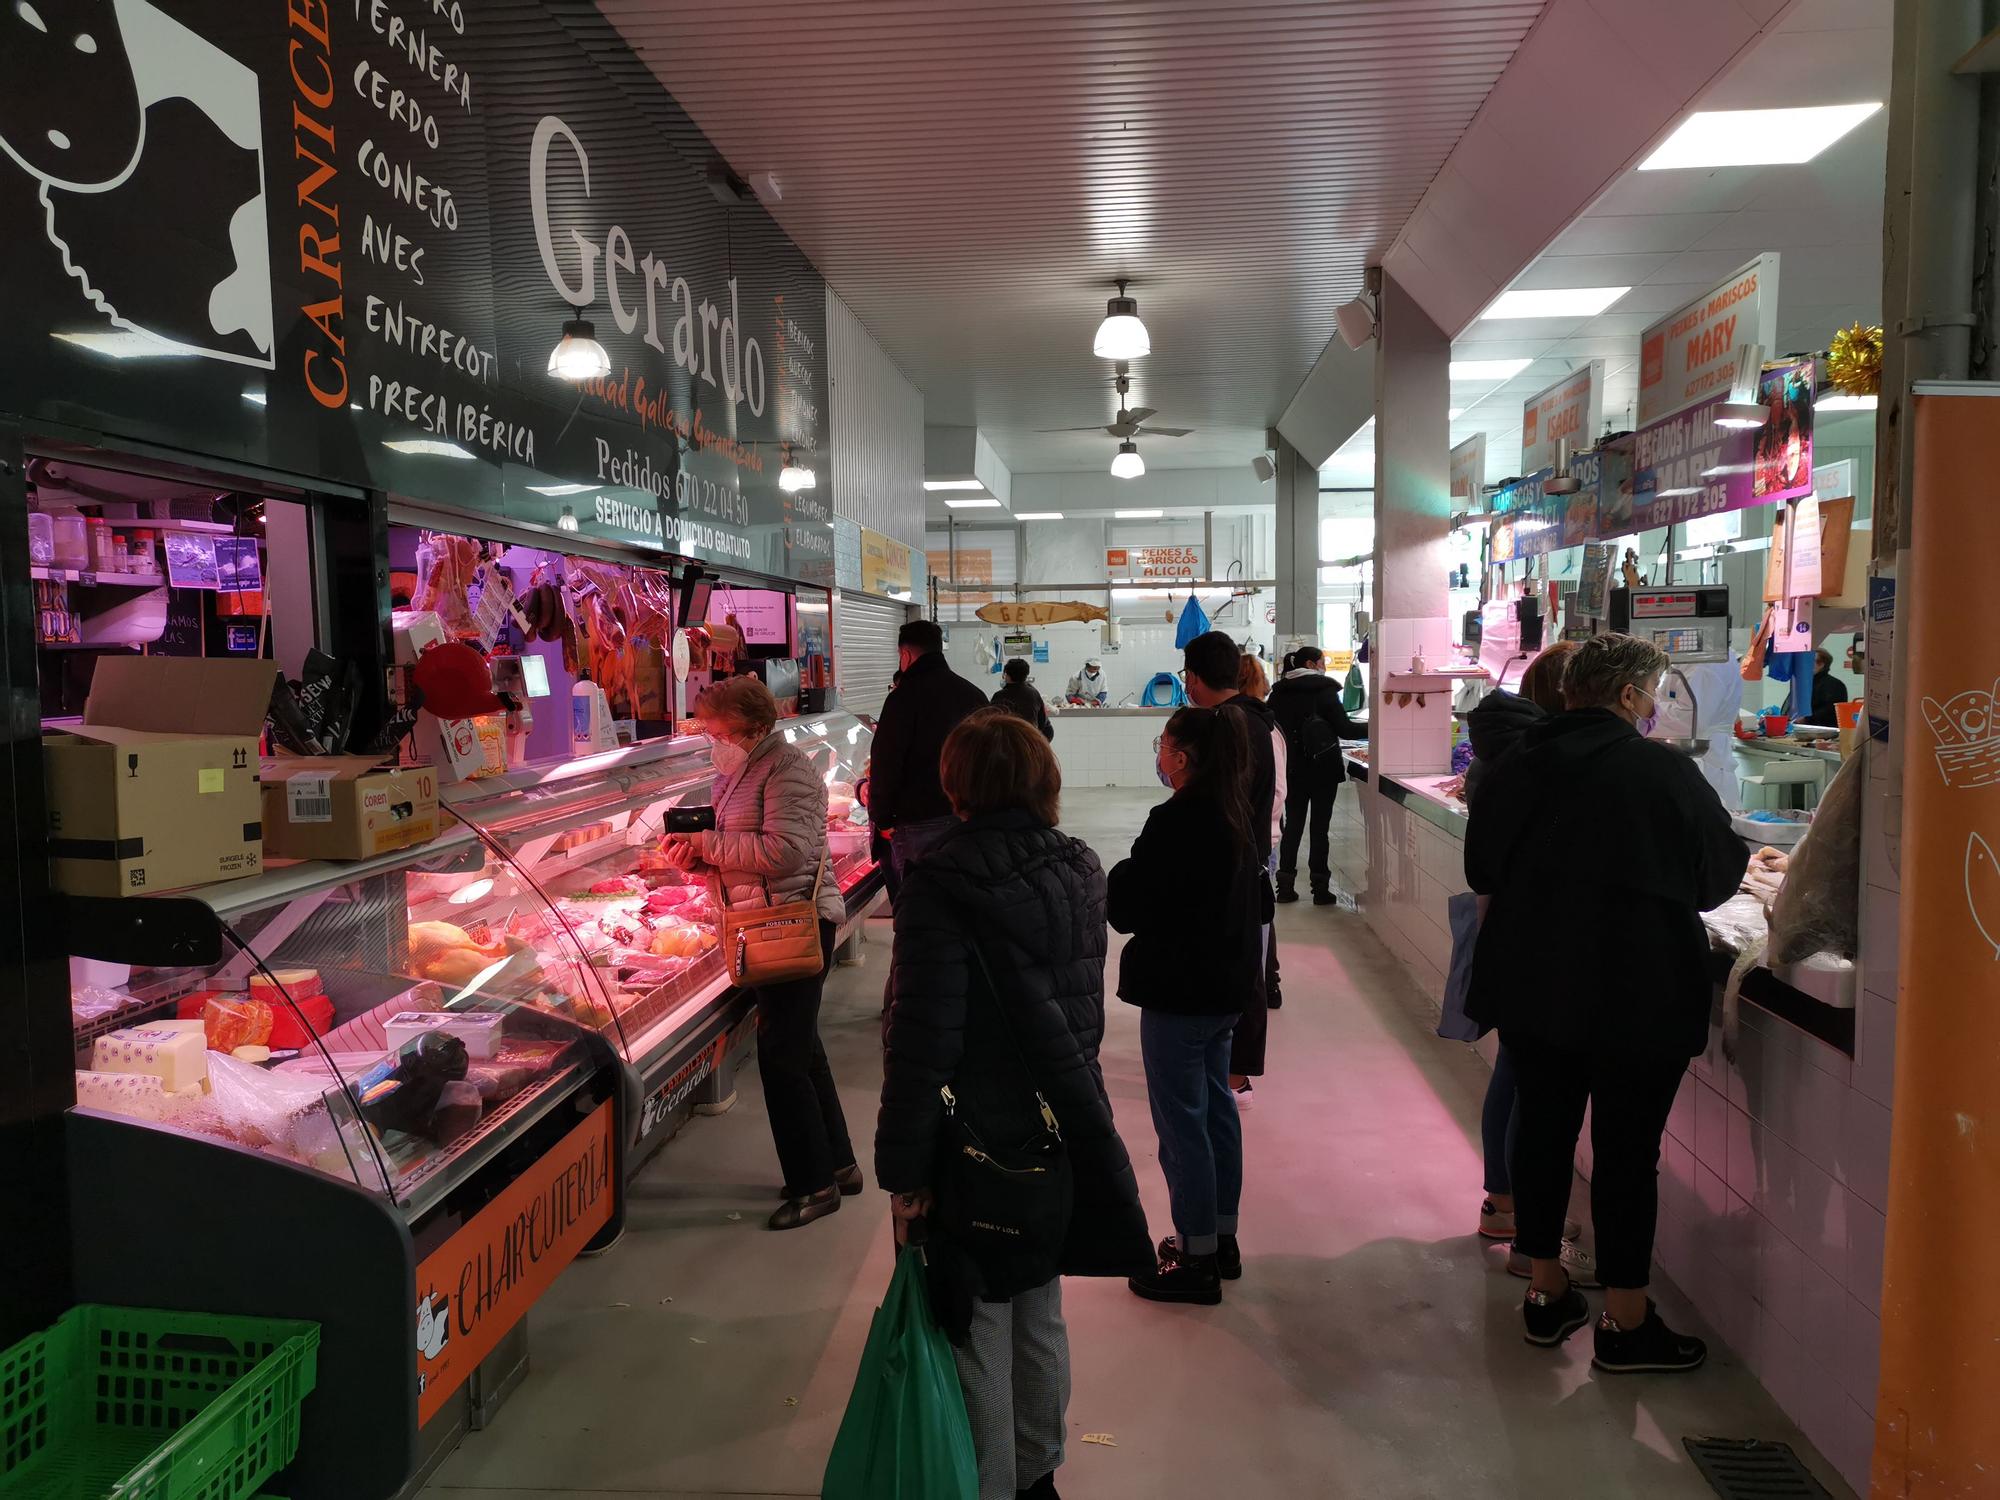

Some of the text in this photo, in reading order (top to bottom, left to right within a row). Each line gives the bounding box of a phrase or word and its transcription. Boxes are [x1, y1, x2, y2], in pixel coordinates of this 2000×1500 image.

[353, 60, 439, 149] CERDO
[358, 139, 458, 231] CONEJO
[362, 215, 425, 285] AVES
[530, 115, 765, 418] Gerardo
[1708, 274, 1757, 318] MARISCOS
[366, 295, 495, 386] ENTRECOT
[1686, 313, 1737, 373] MARY
[370, 375, 535, 465] PRESA IBÉRICA
[1547, 403, 1580, 442] ISABEL
[1635, 417, 1683, 471] PESCADOS
[595, 437, 749, 527] Pedidos 670 22 04 50
[1656, 446, 1721, 489] MARY
[595, 495, 750, 560] SERVICIO A DOMICILIO GRATUITO
[1653, 484, 1727, 525] 627 172 305
[1142, 548, 1193, 557] PEIXES E
[1143, 566, 1192, 576] ALICIA
[1000, 605, 1055, 623] GELI
[416, 776, 431, 800] 10
[219, 863, 242, 872] FROZEN
[655, 1060, 711, 1123] Gerardo
[454, 1133, 609, 1336] CHARCUTERÍA
